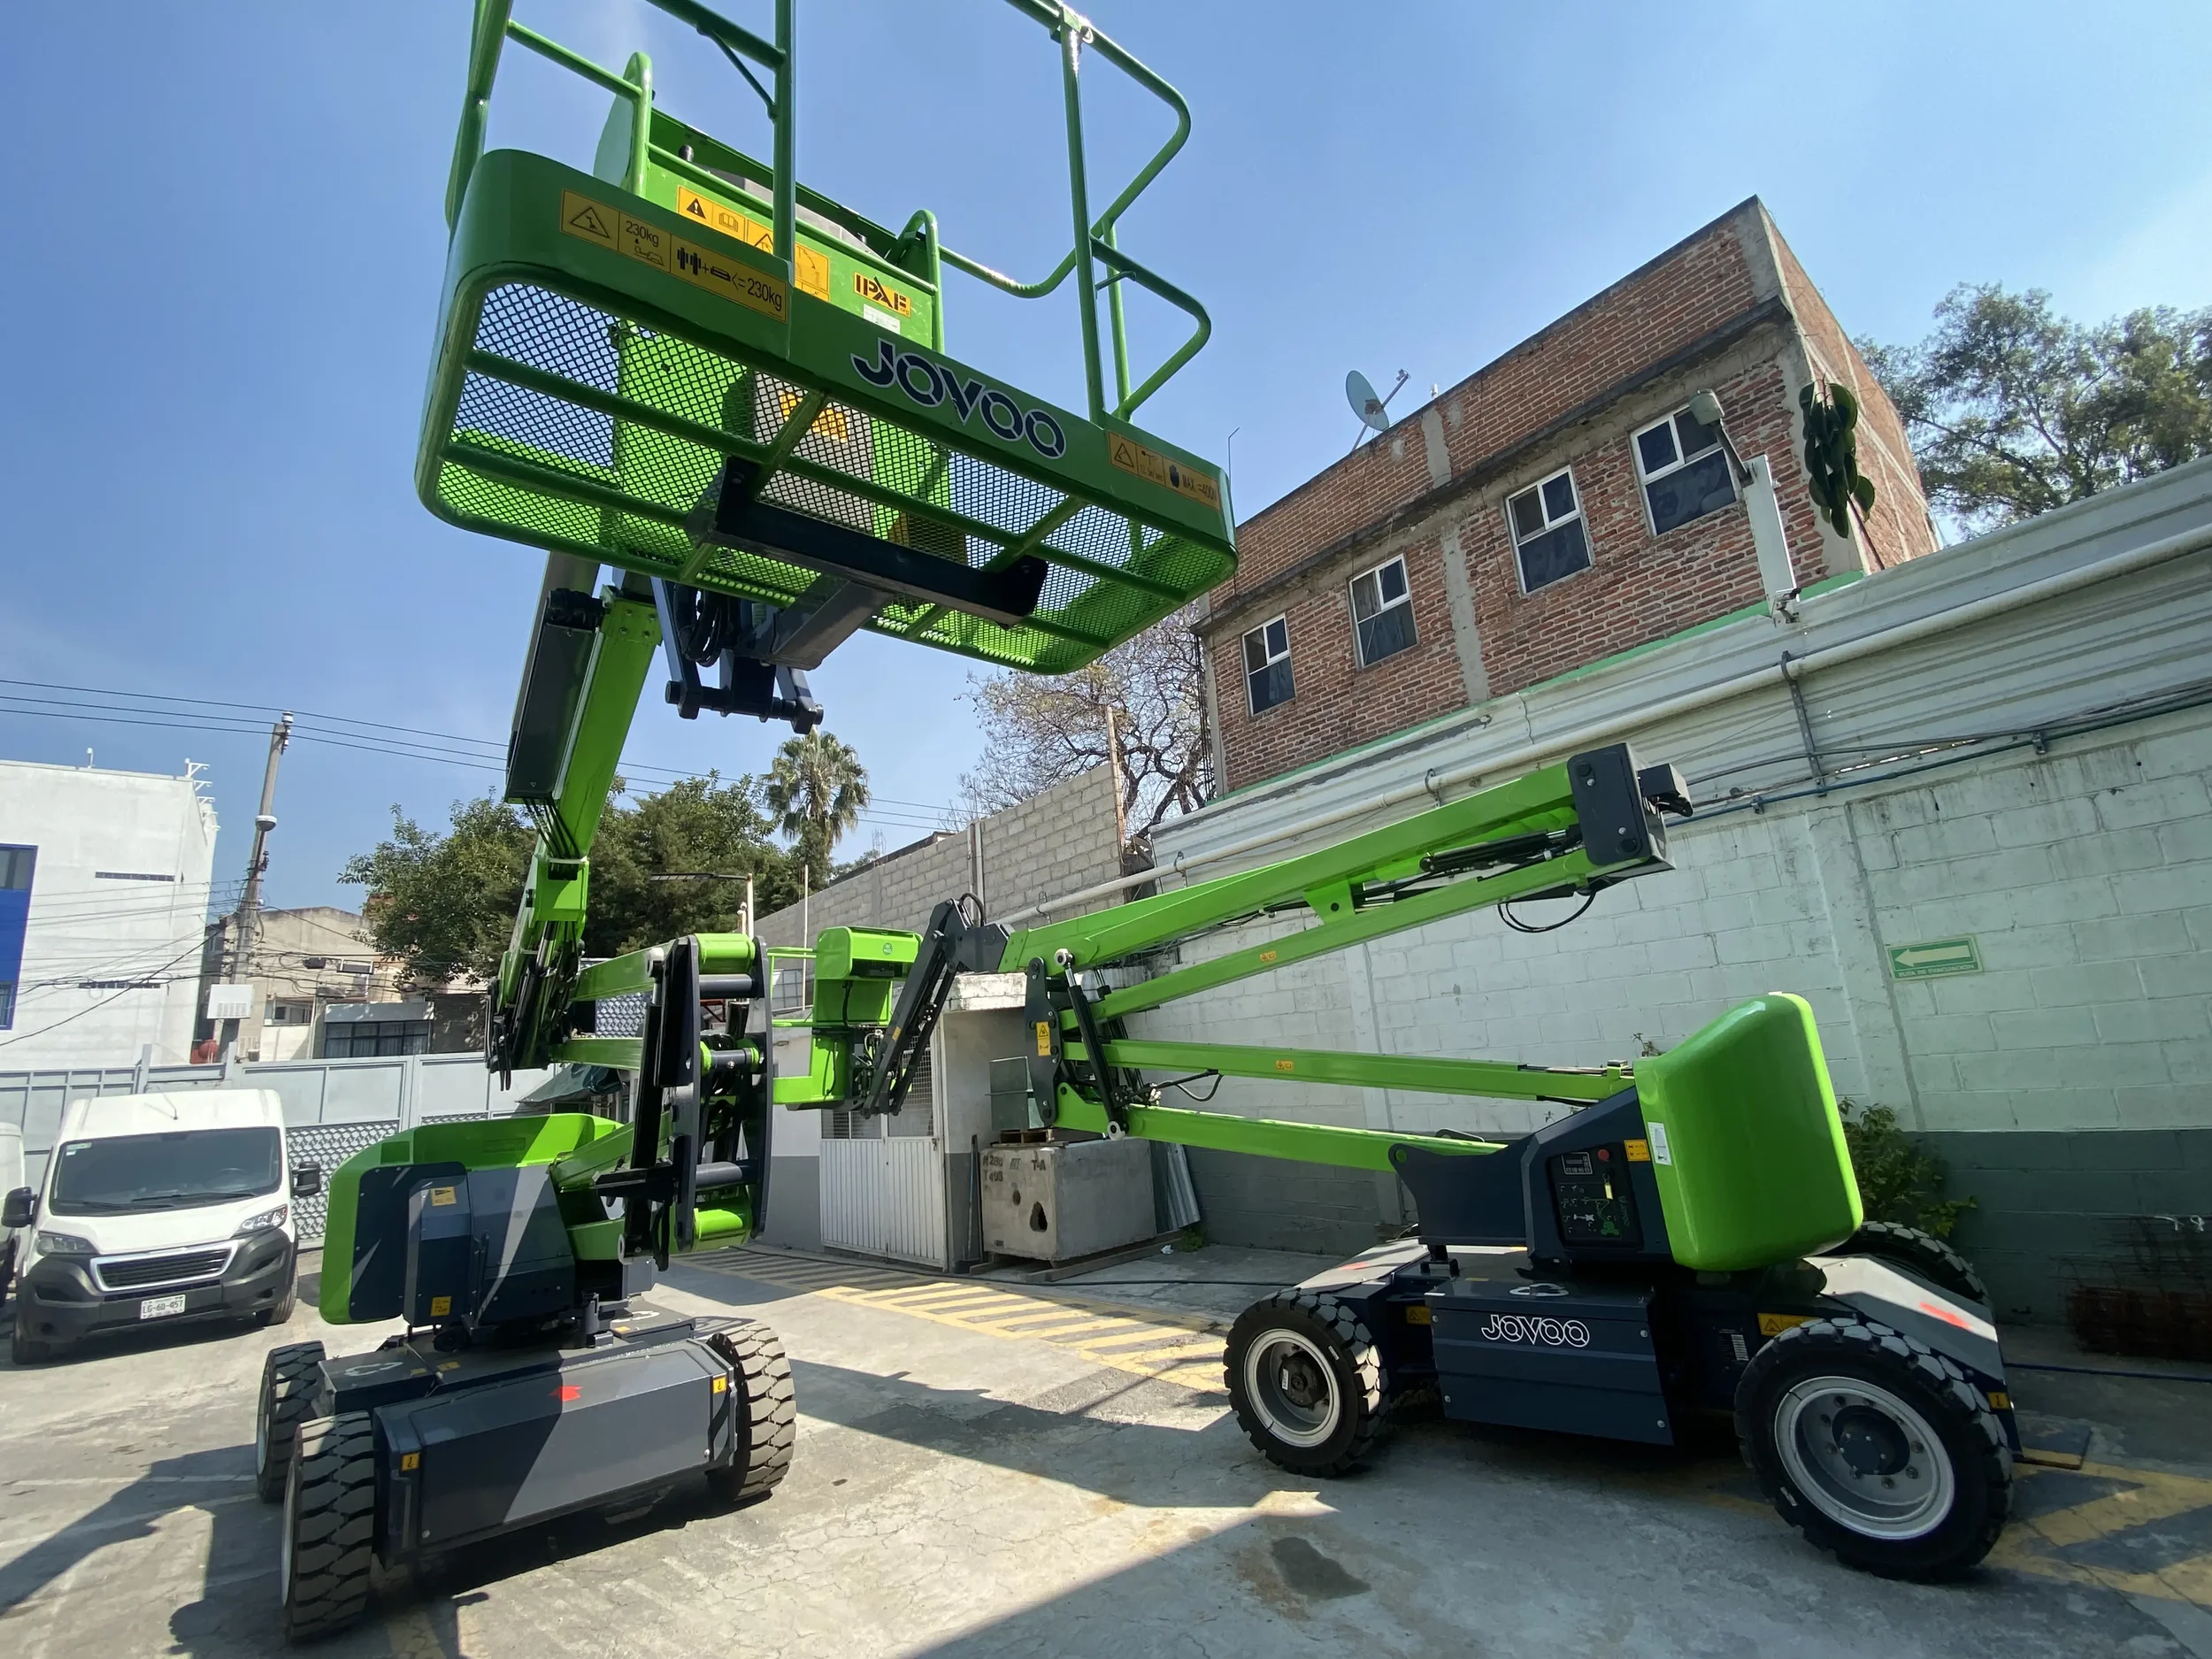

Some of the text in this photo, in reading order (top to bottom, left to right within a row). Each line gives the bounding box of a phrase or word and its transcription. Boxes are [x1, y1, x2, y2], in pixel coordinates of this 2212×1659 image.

[626, 220, 659, 248] 230kg
[856, 274, 907, 311] IPAF
[849, 337, 1067, 460] JOVOO
[1480, 1314, 1590, 1348] JOVOO
